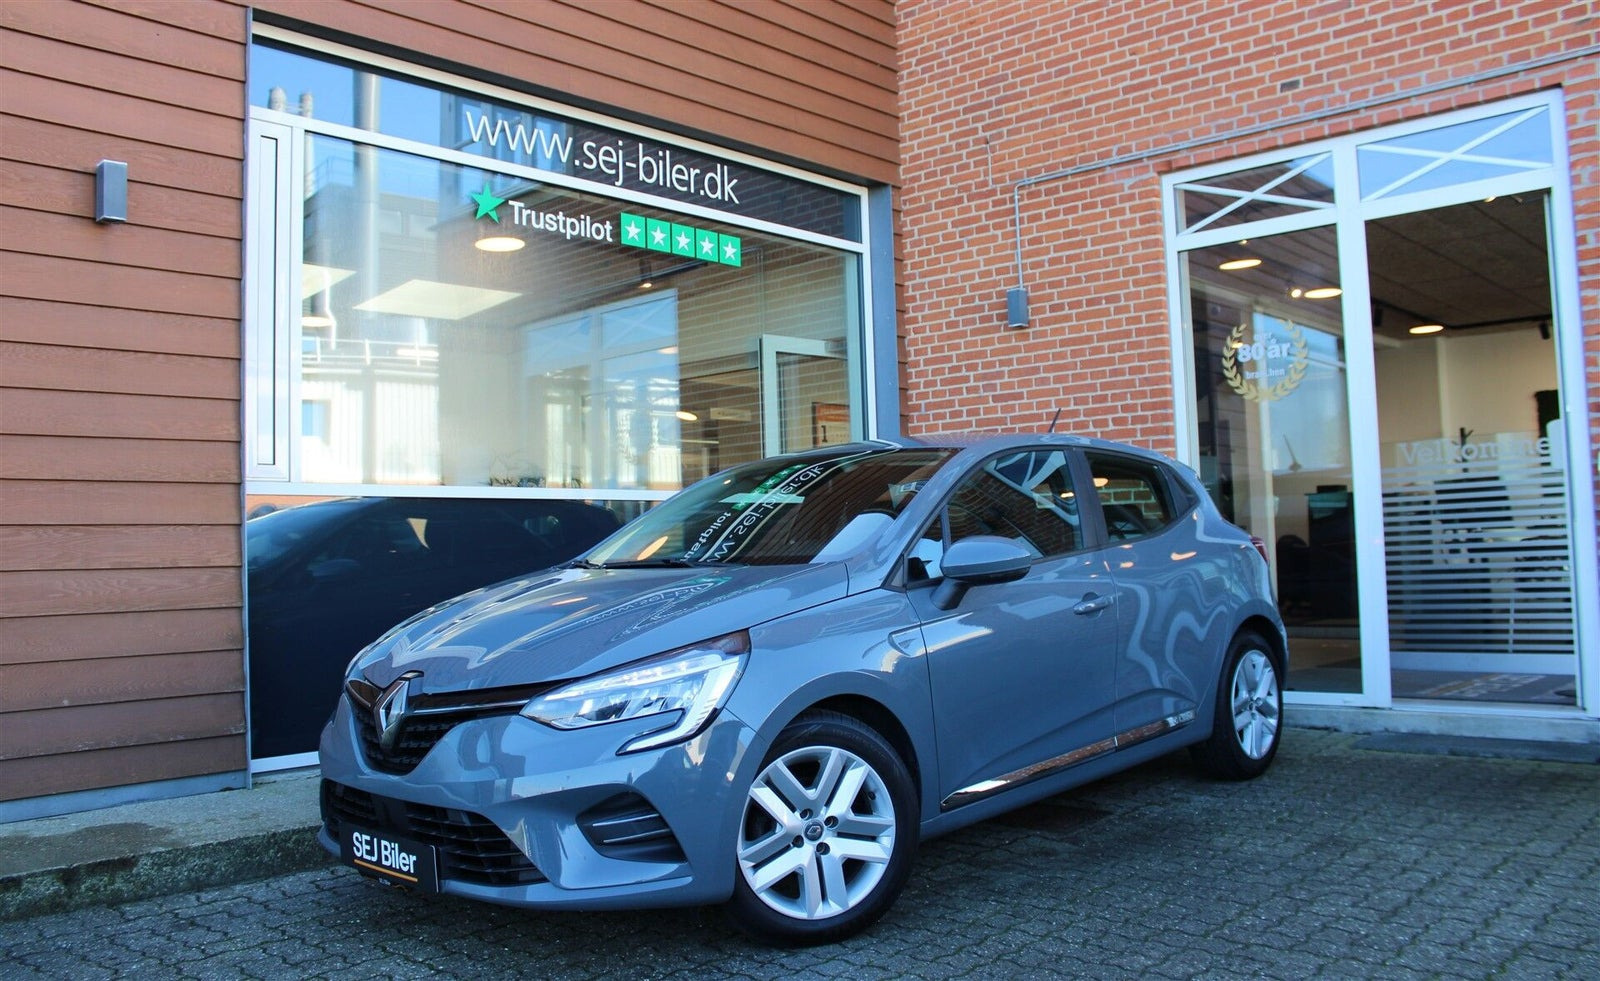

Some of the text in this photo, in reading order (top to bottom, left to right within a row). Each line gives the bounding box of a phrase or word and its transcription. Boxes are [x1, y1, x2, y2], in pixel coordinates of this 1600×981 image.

[465, 111, 739, 205] www.sej-biler.dk
[508, 200, 613, 243] Trustpilot
[1237, 338, 1291, 362] 80 år
[352, 831, 417, 873] SEJ Biler
